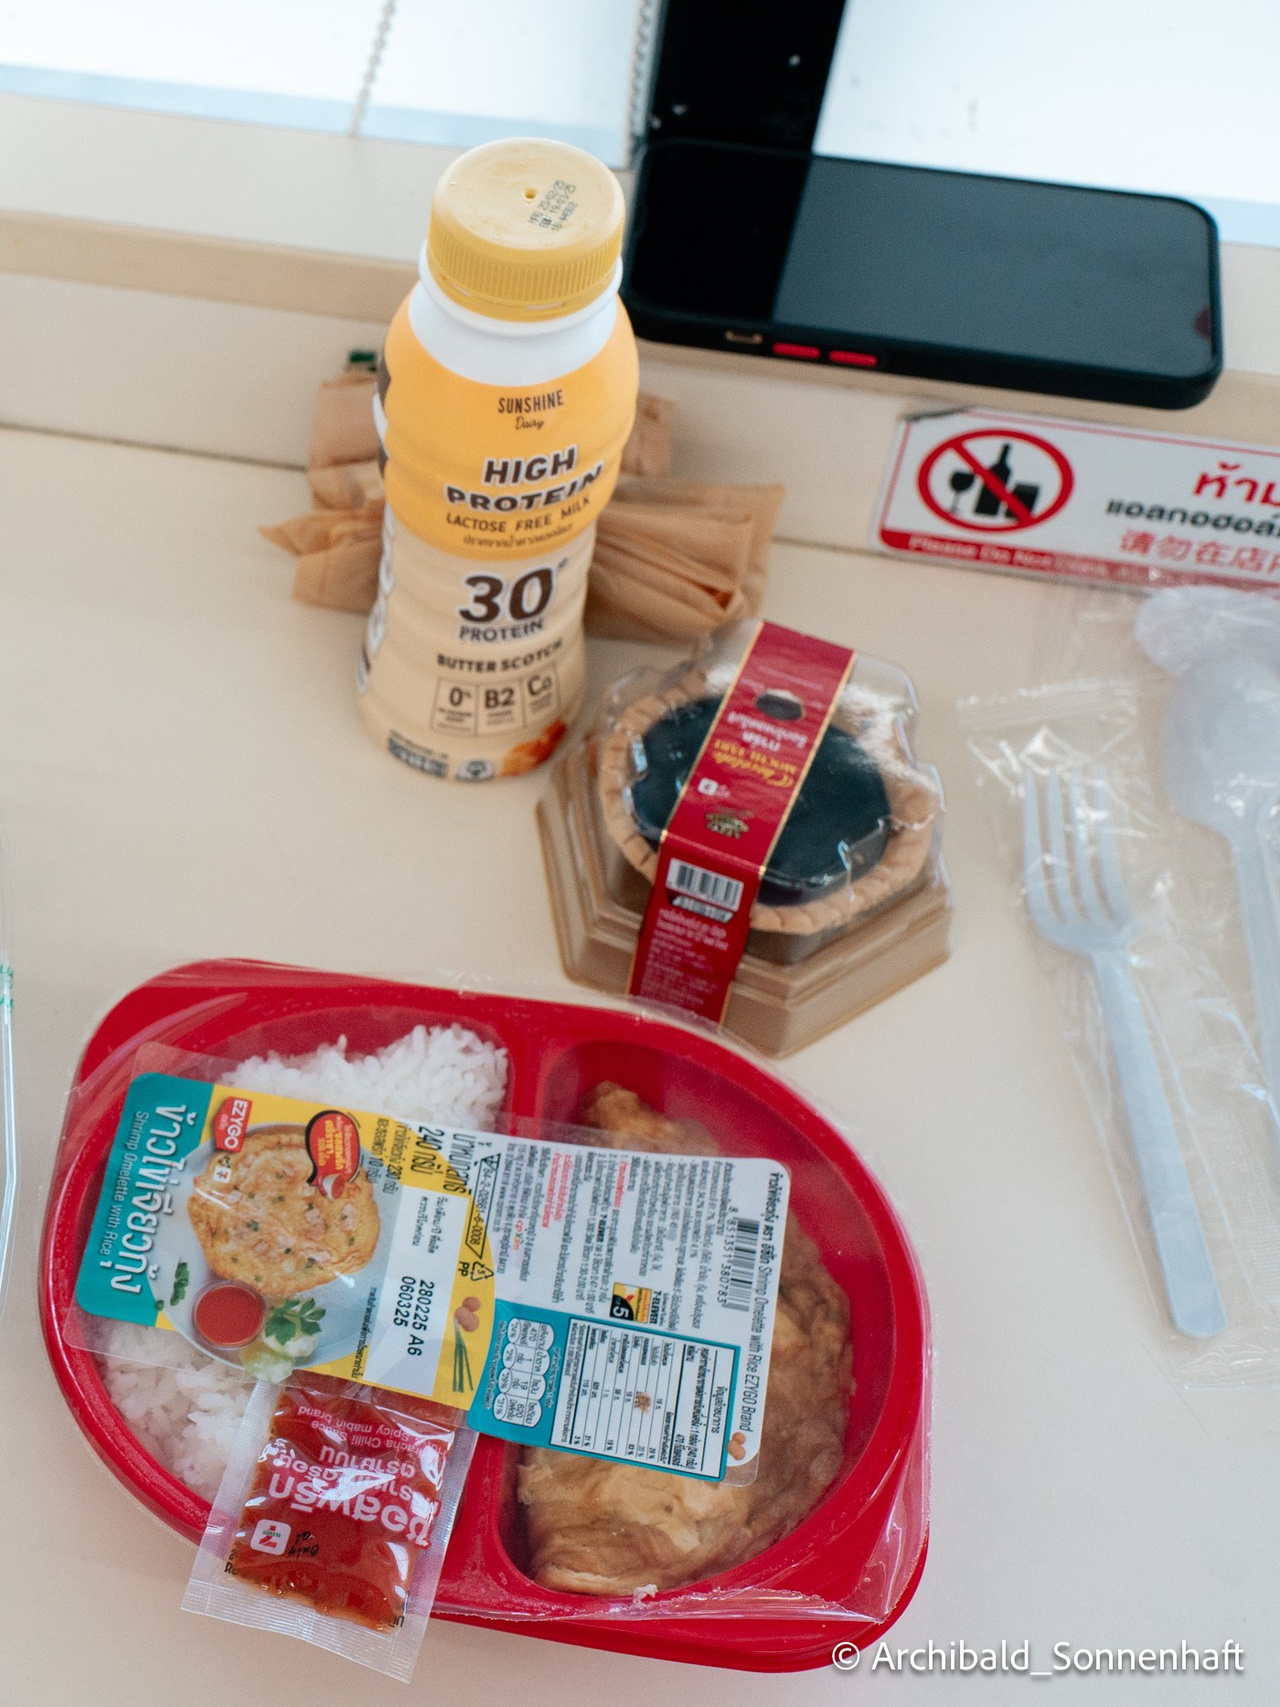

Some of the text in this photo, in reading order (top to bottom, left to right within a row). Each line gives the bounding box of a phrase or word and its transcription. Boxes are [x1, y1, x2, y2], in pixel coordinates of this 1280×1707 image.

[498, 389, 563, 414] SUNSHINE
[515, 416, 545, 430] Dairy
[484, 447, 575, 484] HIGH
[446, 464, 603, 512] PROTEIN
[446, 497, 590, 532] LACTOSE FREE MILK
[458, 568, 555, 624] 30
[459, 618, 544, 642] PROTEIN
[437, 640, 562, 672] BUTTER SCOTCH
[485, 688, 515, 709] B2
[223, 1098, 247, 1150] EZYGO
[409, 1126, 445, 1176] 240 กรัม
[99, 1110, 149, 1256] Shrimp Omelette with Rice
[385, 1164, 403, 1180] 230
[93, 1099, 198, 1297] ข้าวไข่เจียวกุ้ง
[456, 1261, 469, 1277] PP
[754, 1265, 772, 1295] Shrimp
[392, 1275, 416, 1327] 060325
[612, 1305, 628, 1317] 5
[406, 1279, 435, 1357] 280225 A6
[750, 1296, 768, 1334] Omelette
[528, 1327, 537, 1341] 470
[748, 1334, 762, 1352] with
[746, 1353, 761, 1373] Rice
[520, 1380, 528, 1390] 19
[741, 1374, 759, 1405] EZYGO
[297, 1405, 332, 1422] brand
[515, 1402, 524, 1418] 620
[738, 1405, 755, 1432] Brand
[335, 1417, 372, 1434] mabin
[375, 1422, 409, 1442] Spicy
[350, 1432, 381, 1450] Chilli
